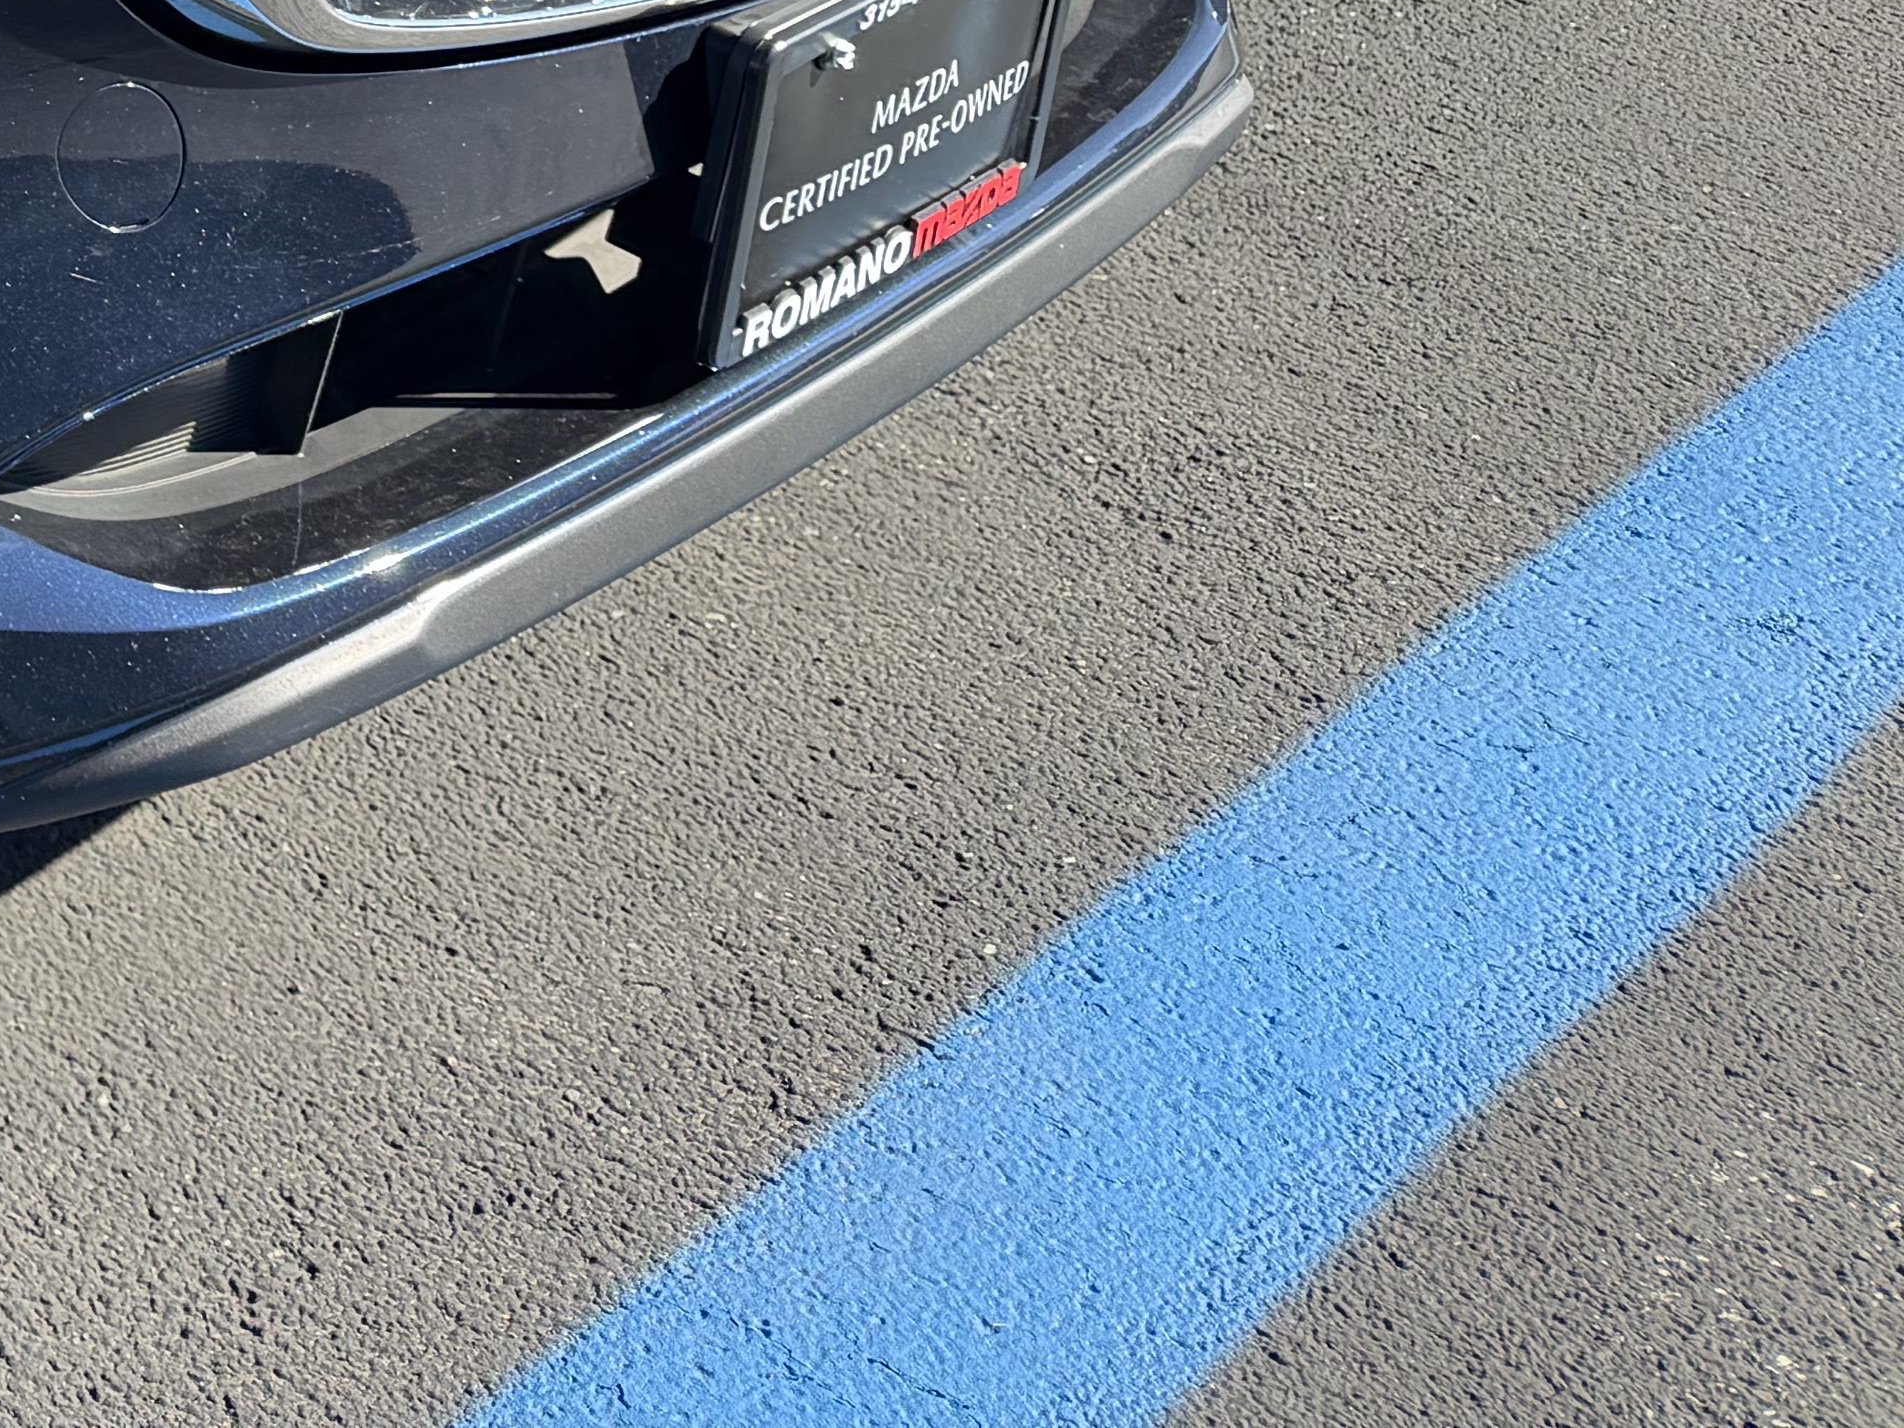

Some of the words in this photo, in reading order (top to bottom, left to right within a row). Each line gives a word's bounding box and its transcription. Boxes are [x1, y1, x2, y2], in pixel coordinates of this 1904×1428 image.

[759, 144, 893, 232] CERTIFIED
[899, 60, 1030, 165] PRE-OWNED
[871, 59, 959, 134] MAZDA
